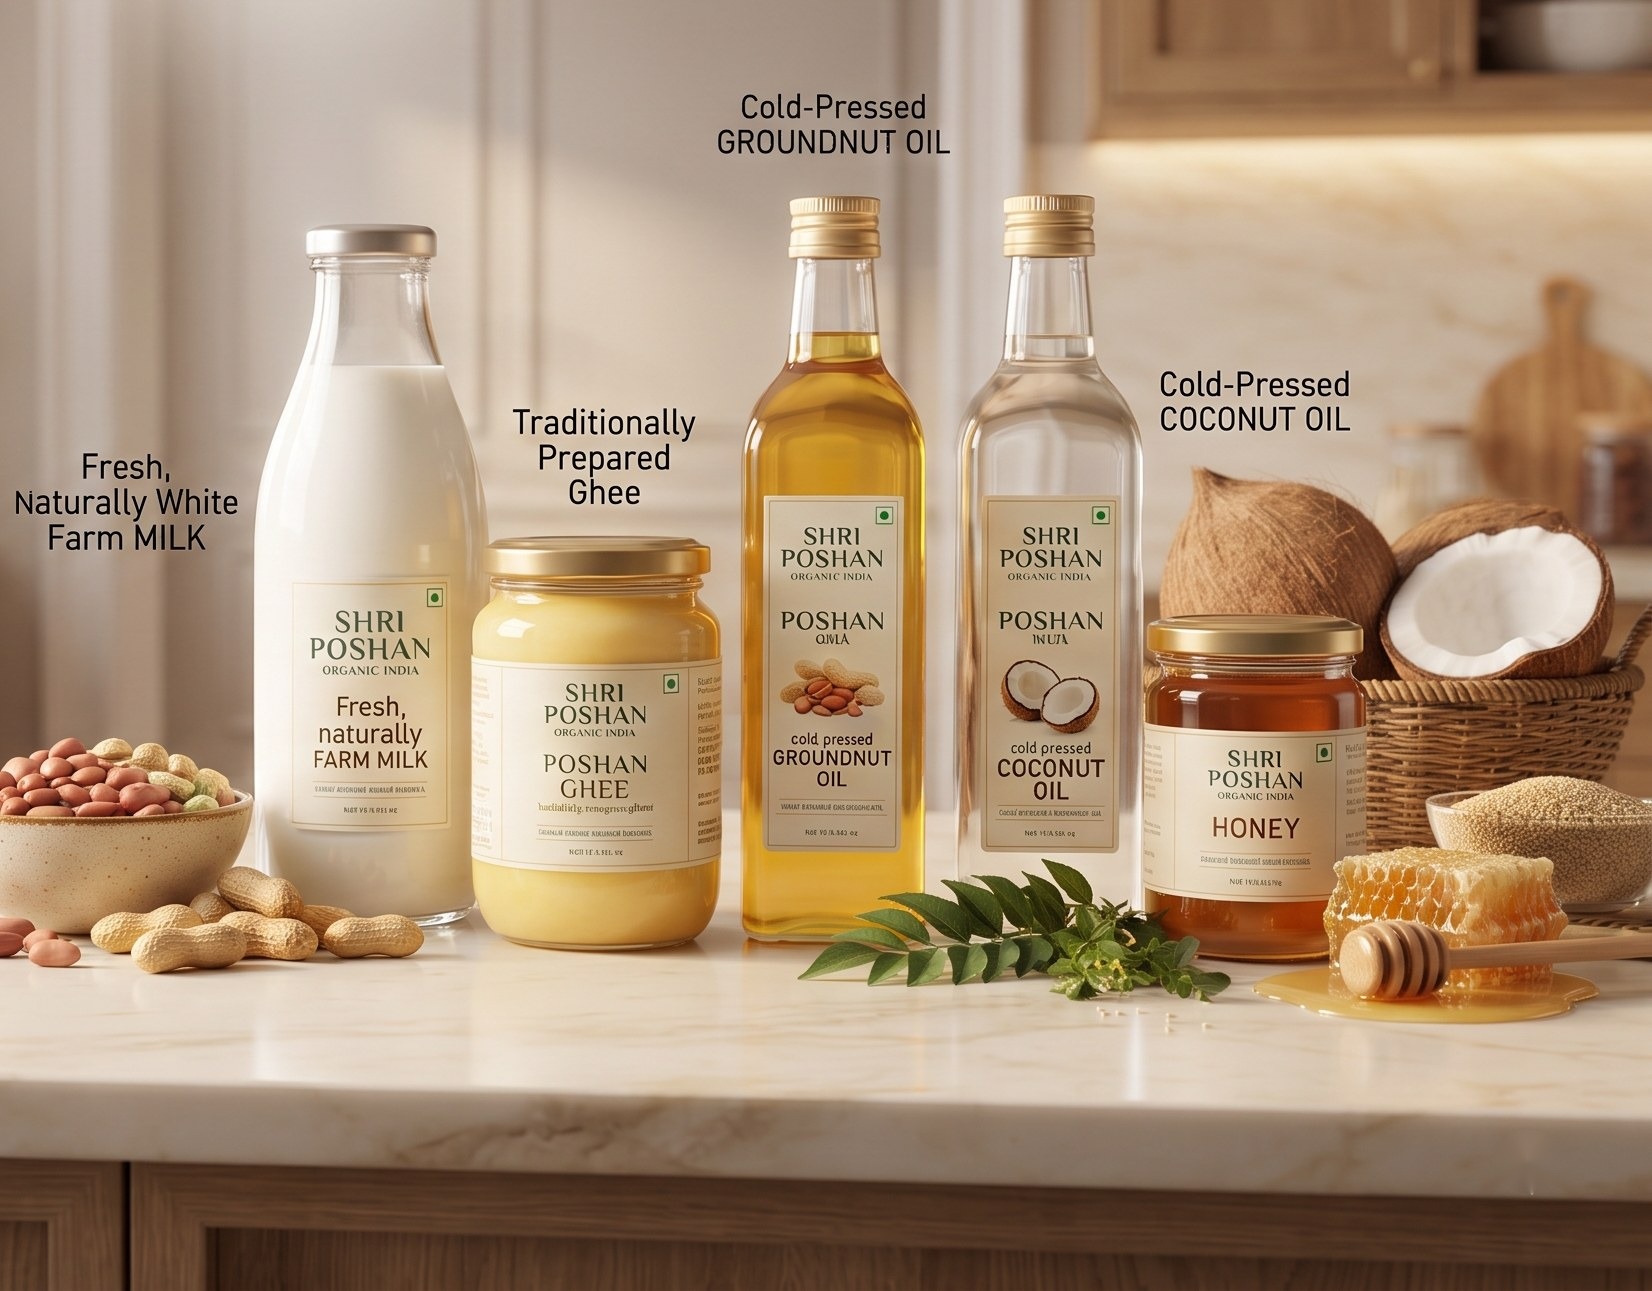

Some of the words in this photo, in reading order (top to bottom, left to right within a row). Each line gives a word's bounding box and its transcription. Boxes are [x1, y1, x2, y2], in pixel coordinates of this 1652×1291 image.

[803, 526, 860, 546] SHRI
[1022, 526, 1079, 546] SHRI
[781, 549, 883, 568] POSHAN
[999, 549, 1102, 568] POSHAN
[790, 572, 840, 581] ORGANIC
[843, 572, 873, 581] INDIA
[1007, 572, 1057, 581] ORGANIC
[1060, 572, 1091, 581] INDIA
[335, 610, 403, 633] SHRI
[781, 611, 884, 631] POSHAN
[998, 611, 1103, 631] POSHAN
[310, 637, 430, 660] POSHAN
[322, 665, 379, 676] ORGANIC
[384, 665, 419, 676] INDIA
[565, 683, 623, 702] SHRI
[337, 695, 406, 720] Fresh,
[544, 705, 646, 725] POSHAN
[319, 722, 423, 749] naturally
[554, 728, 602, 737] ORGANIC
[606, 728, 636, 737] INDIA
[791, 732, 819, 746] cold
[823, 732, 873, 748] pressed
[773, 750, 892, 766] GROUNDNUT
[1011, 741, 1037, 754] cold
[1041, 741, 1091, 756] pressed
[314, 750, 369, 769] FARM
[377, 750, 428, 769] MILK
[543, 754, 647, 775] POSHAN
[997, 758, 1105, 778] COCONUT
[1228, 750, 1282, 768] SHRI
[816, 771, 847, 787] OIL
[1207, 770, 1303, 789] POSHAN
[560, 779, 629, 799] GHEE
[1033, 781, 1069, 800] OIL
[1217, 792, 1263, 801] ORGANIC
[1266, 792, 1295, 801] INDIA
[1212, 816, 1301, 839] HONEY
